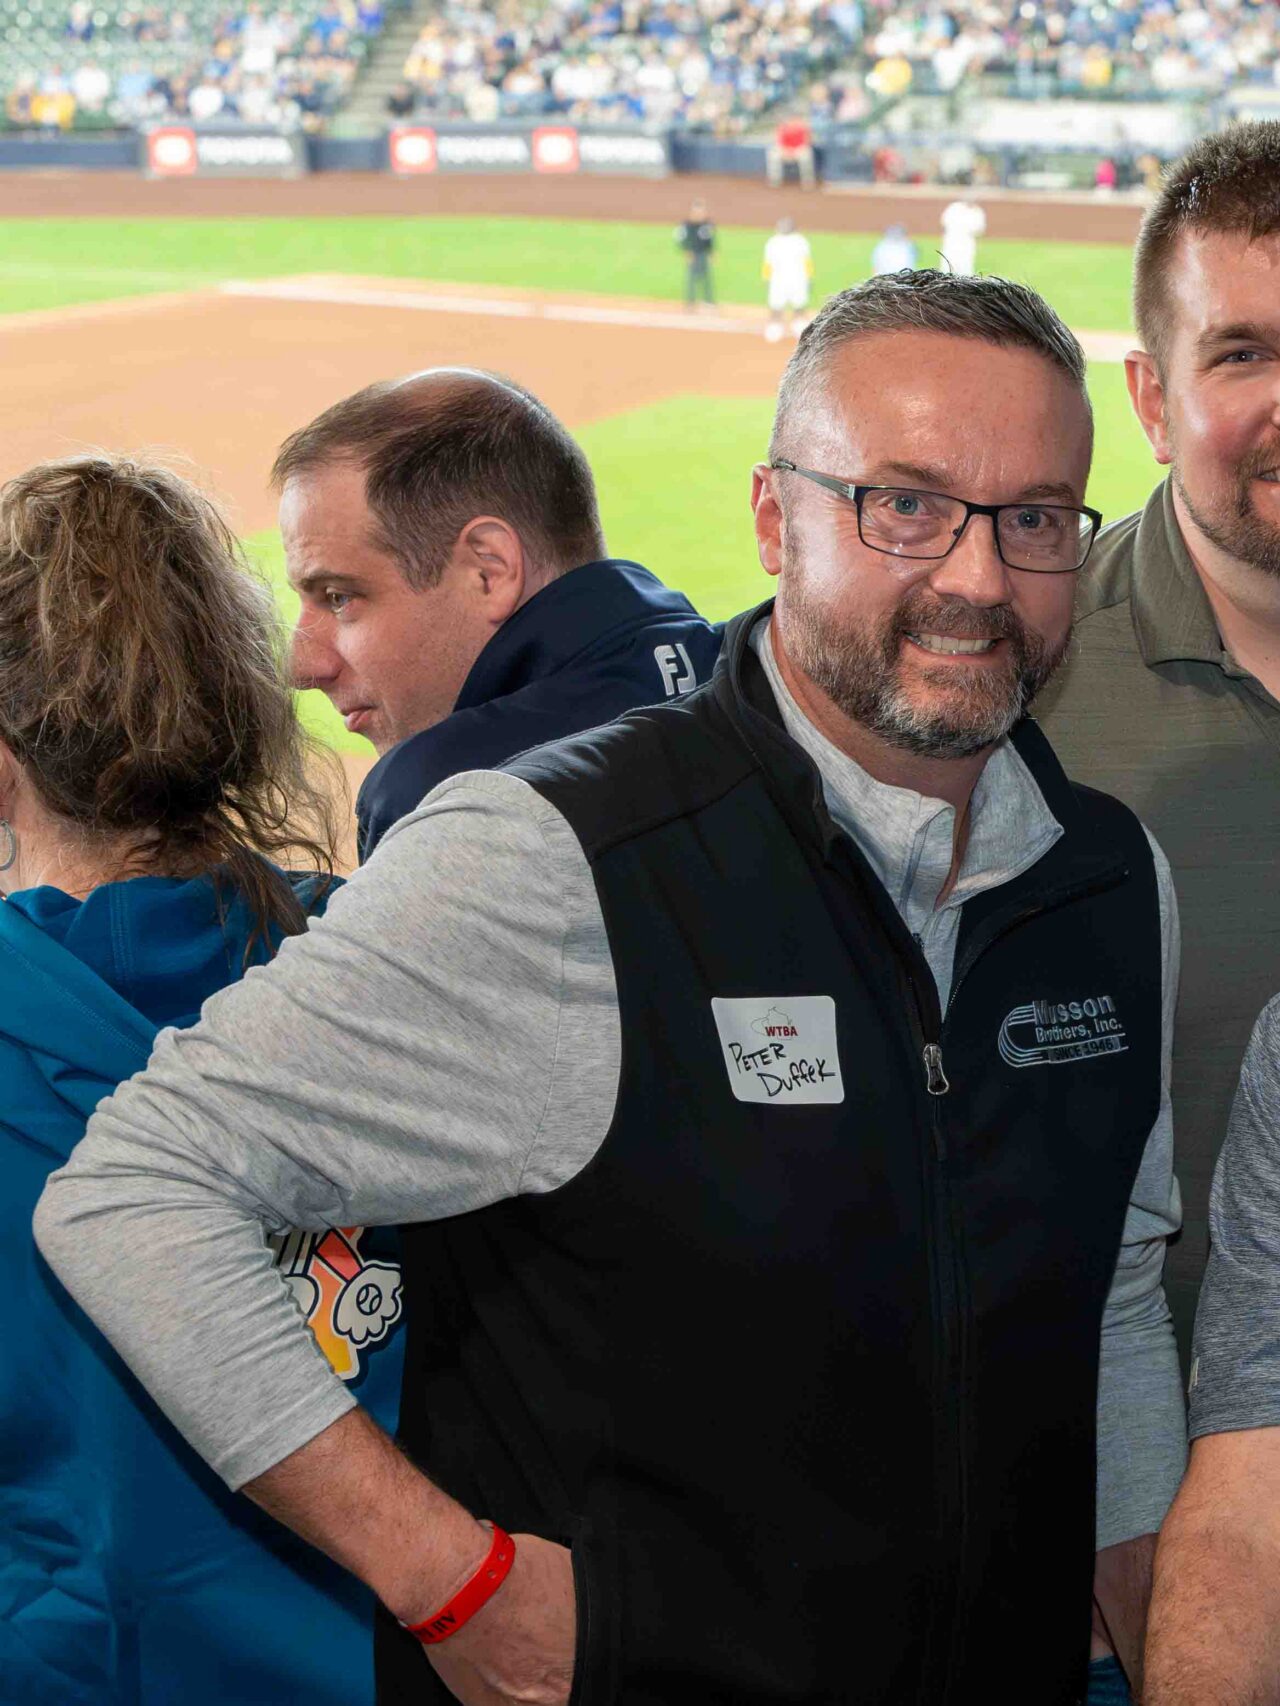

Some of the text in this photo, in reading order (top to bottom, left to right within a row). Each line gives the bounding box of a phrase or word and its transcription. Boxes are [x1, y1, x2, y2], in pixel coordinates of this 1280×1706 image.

[653, 643, 697, 696] FJ
[764, 1026, 799, 1037] WTBA
[1094, 1017, 1123, 1033] Inc.
